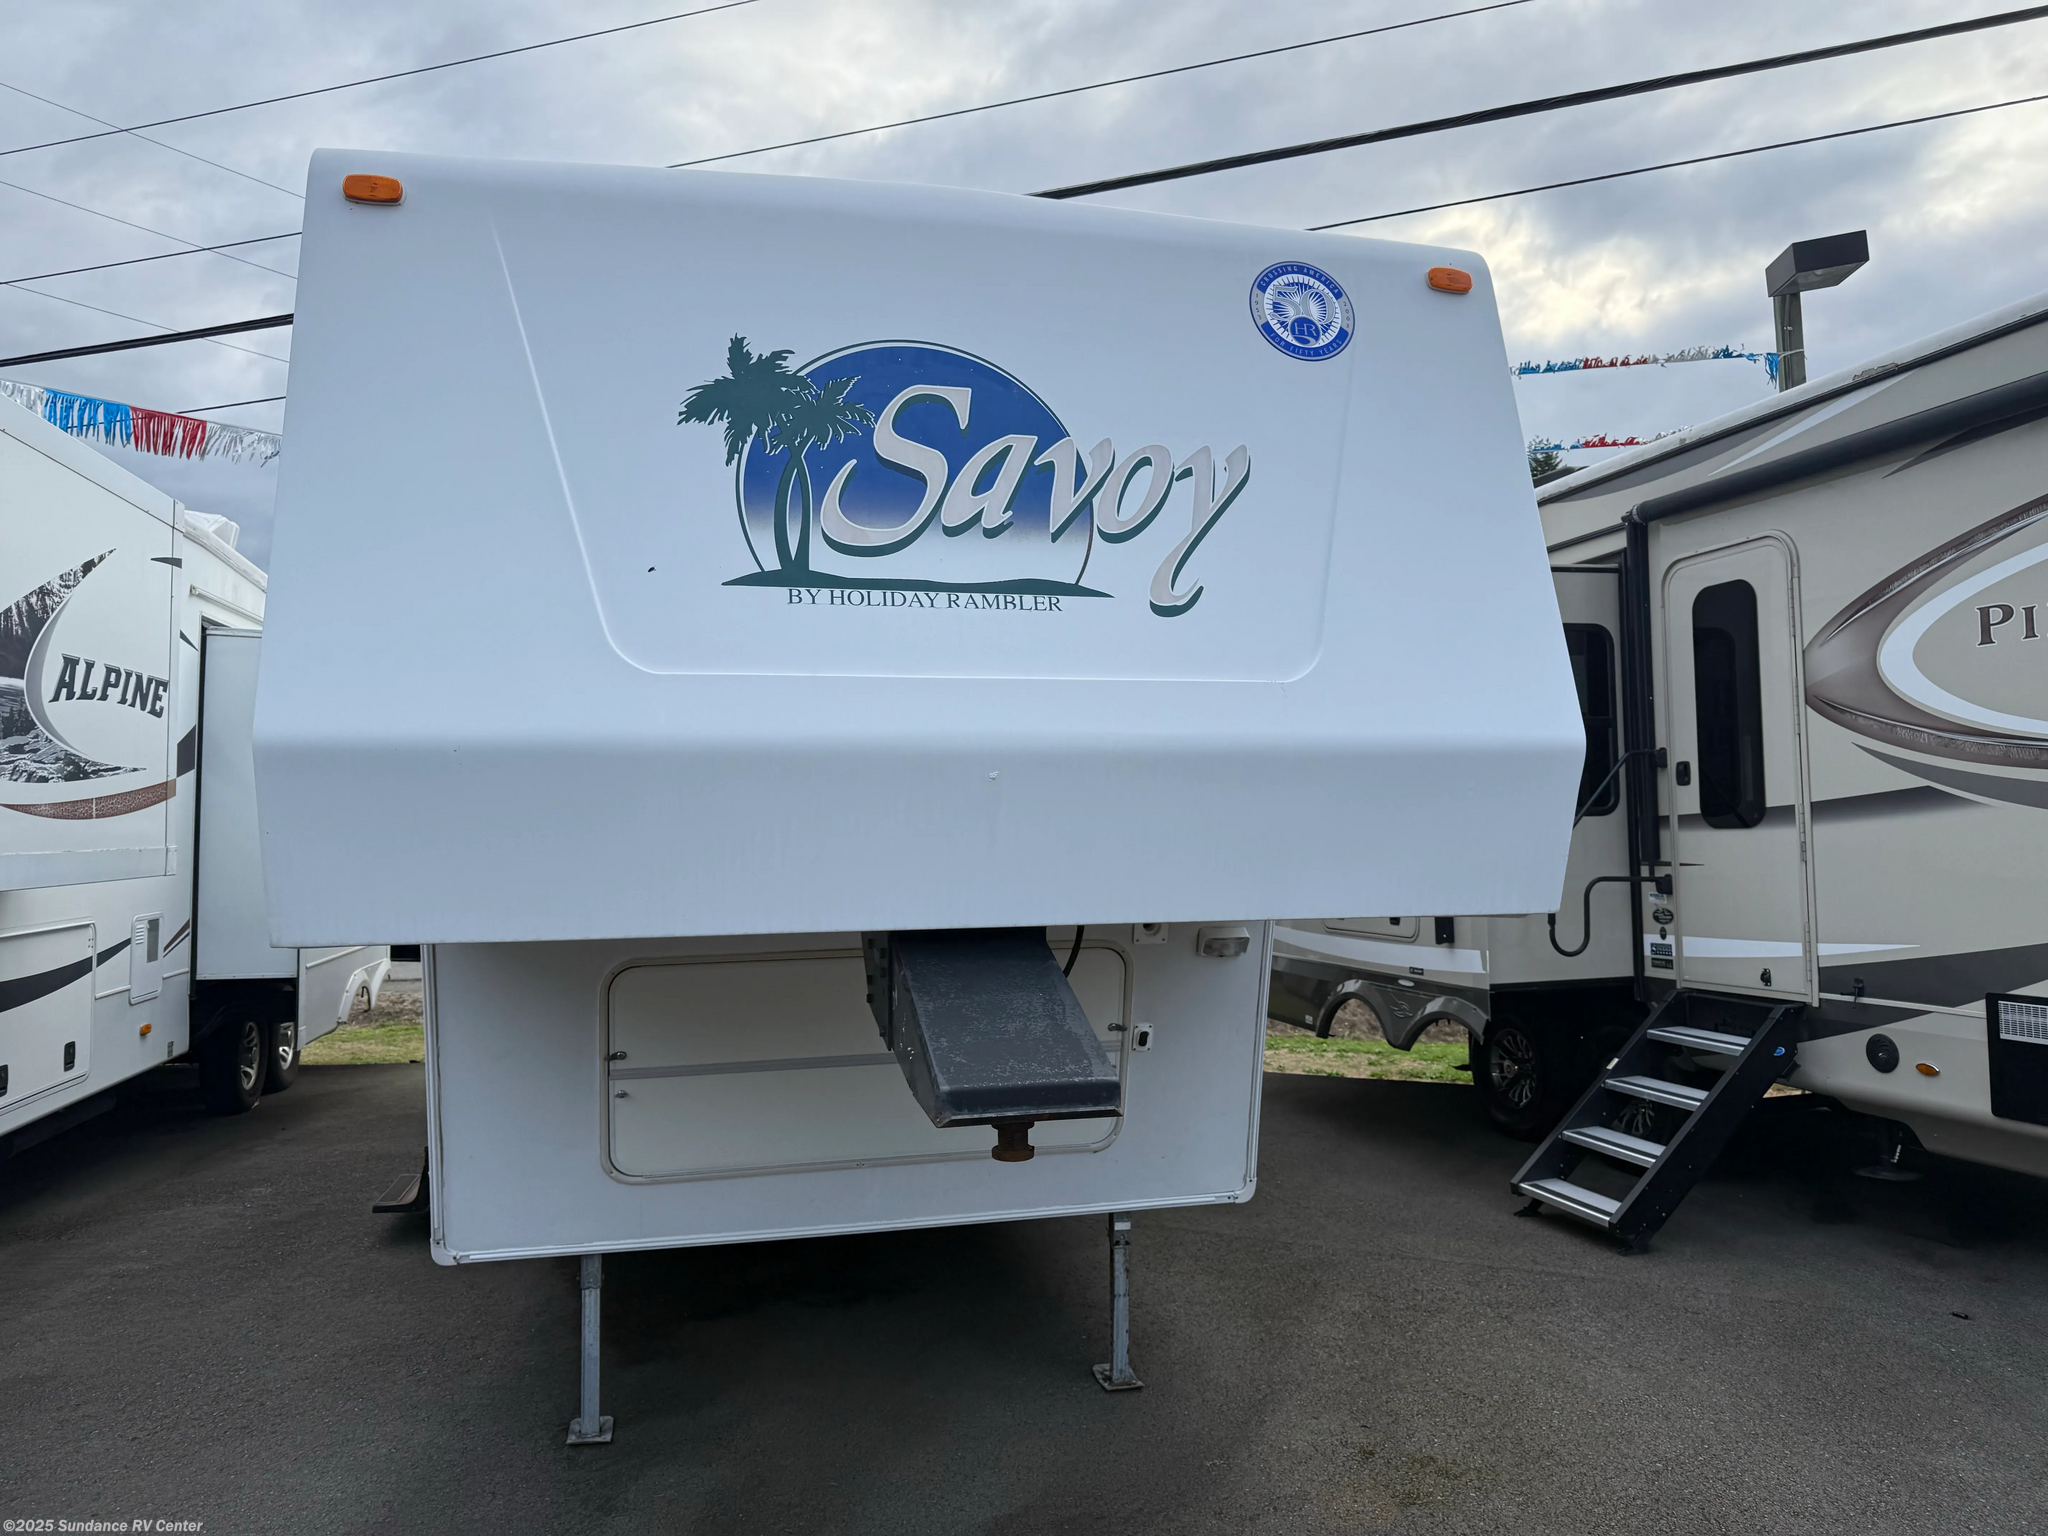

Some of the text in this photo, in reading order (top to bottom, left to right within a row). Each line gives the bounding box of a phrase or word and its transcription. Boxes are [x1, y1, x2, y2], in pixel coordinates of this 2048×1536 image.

[1260, 265, 1339, 294] CROSSING AMERICA
[1269, 283, 1336, 325] 50
[1269, 333, 1343, 357] FOR FIFTY YEARS
[1294, 322, 1318, 337] HR
[820, 384, 1252, 618] Savoy
[787, 587, 1064, 612] BY HOLIDAY RAMBLER
[1974, 602, 2048, 648] PI
[48, 652, 170, 720] ALPINE
